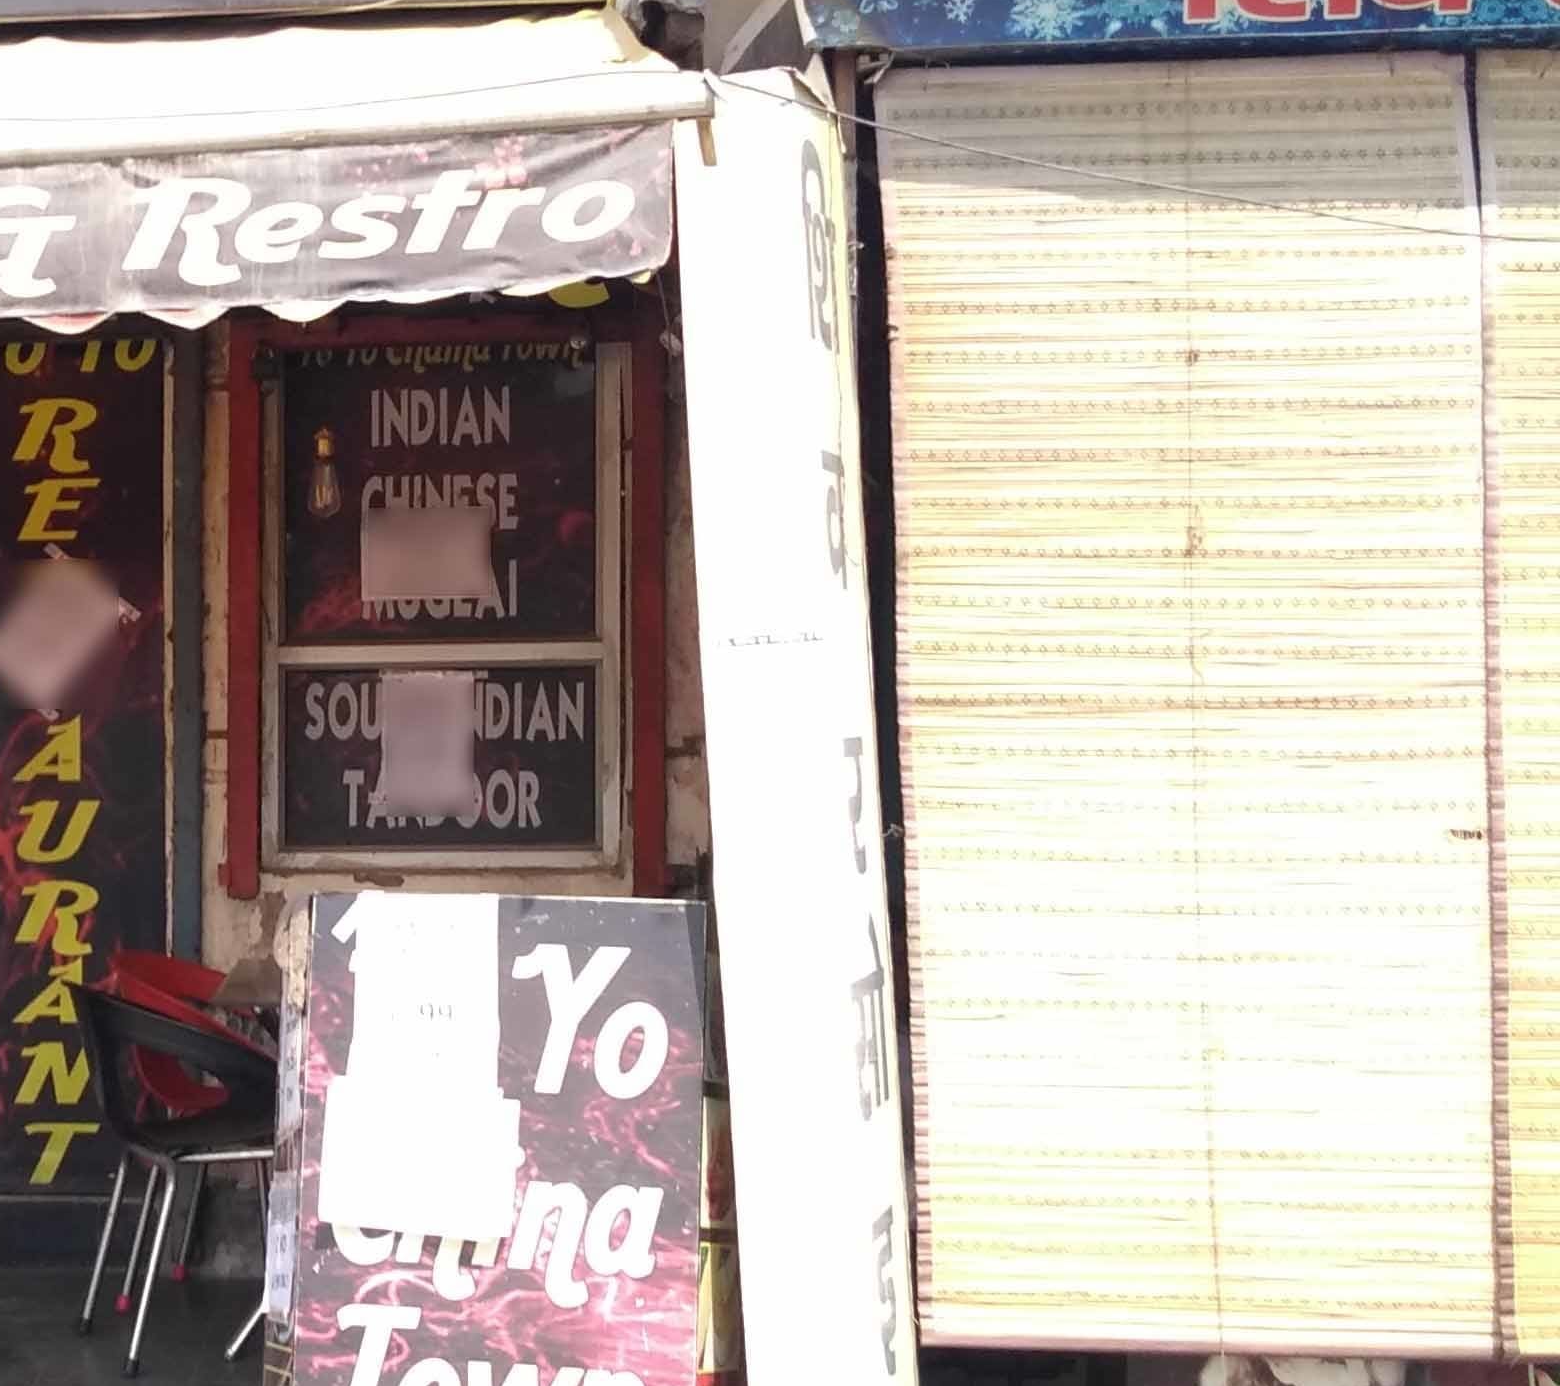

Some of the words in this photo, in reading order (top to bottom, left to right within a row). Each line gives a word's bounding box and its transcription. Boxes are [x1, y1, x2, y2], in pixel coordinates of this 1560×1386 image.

[120, 168, 636, 287] Restro
[371, 385, 510, 448] INDIAN
[512, 942, 669, 1100] Yo
